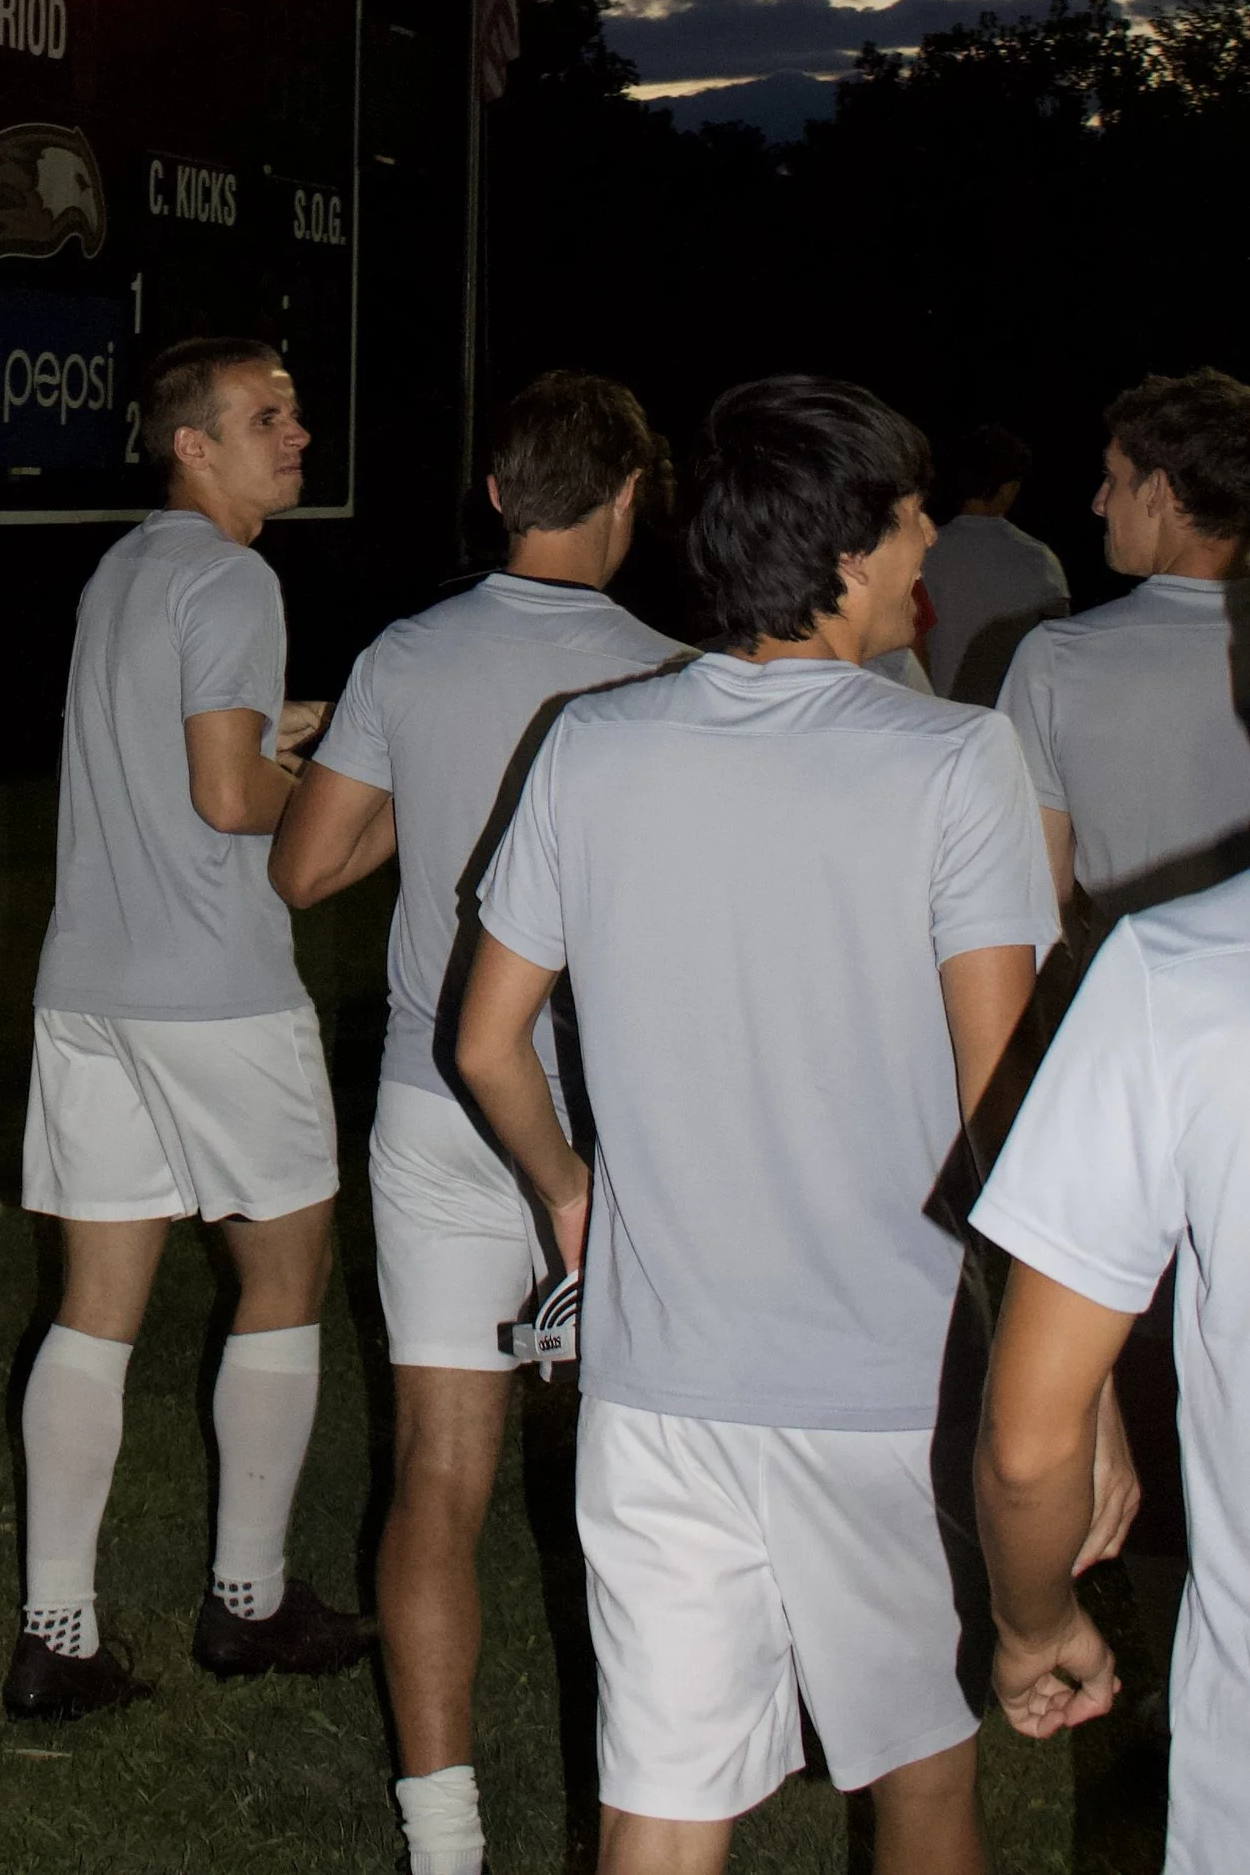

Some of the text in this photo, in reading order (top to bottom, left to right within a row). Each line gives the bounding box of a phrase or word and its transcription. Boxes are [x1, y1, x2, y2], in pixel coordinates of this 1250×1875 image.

[150, 159, 237, 226] C. KICKS
[294, 189, 347, 246] S.O.G.
[130, 272, 143, 334] 1
[3, 340, 114, 425] pepsi
[126, 400, 141, 464] 2
[539, 1335, 561, 1351] adidas
